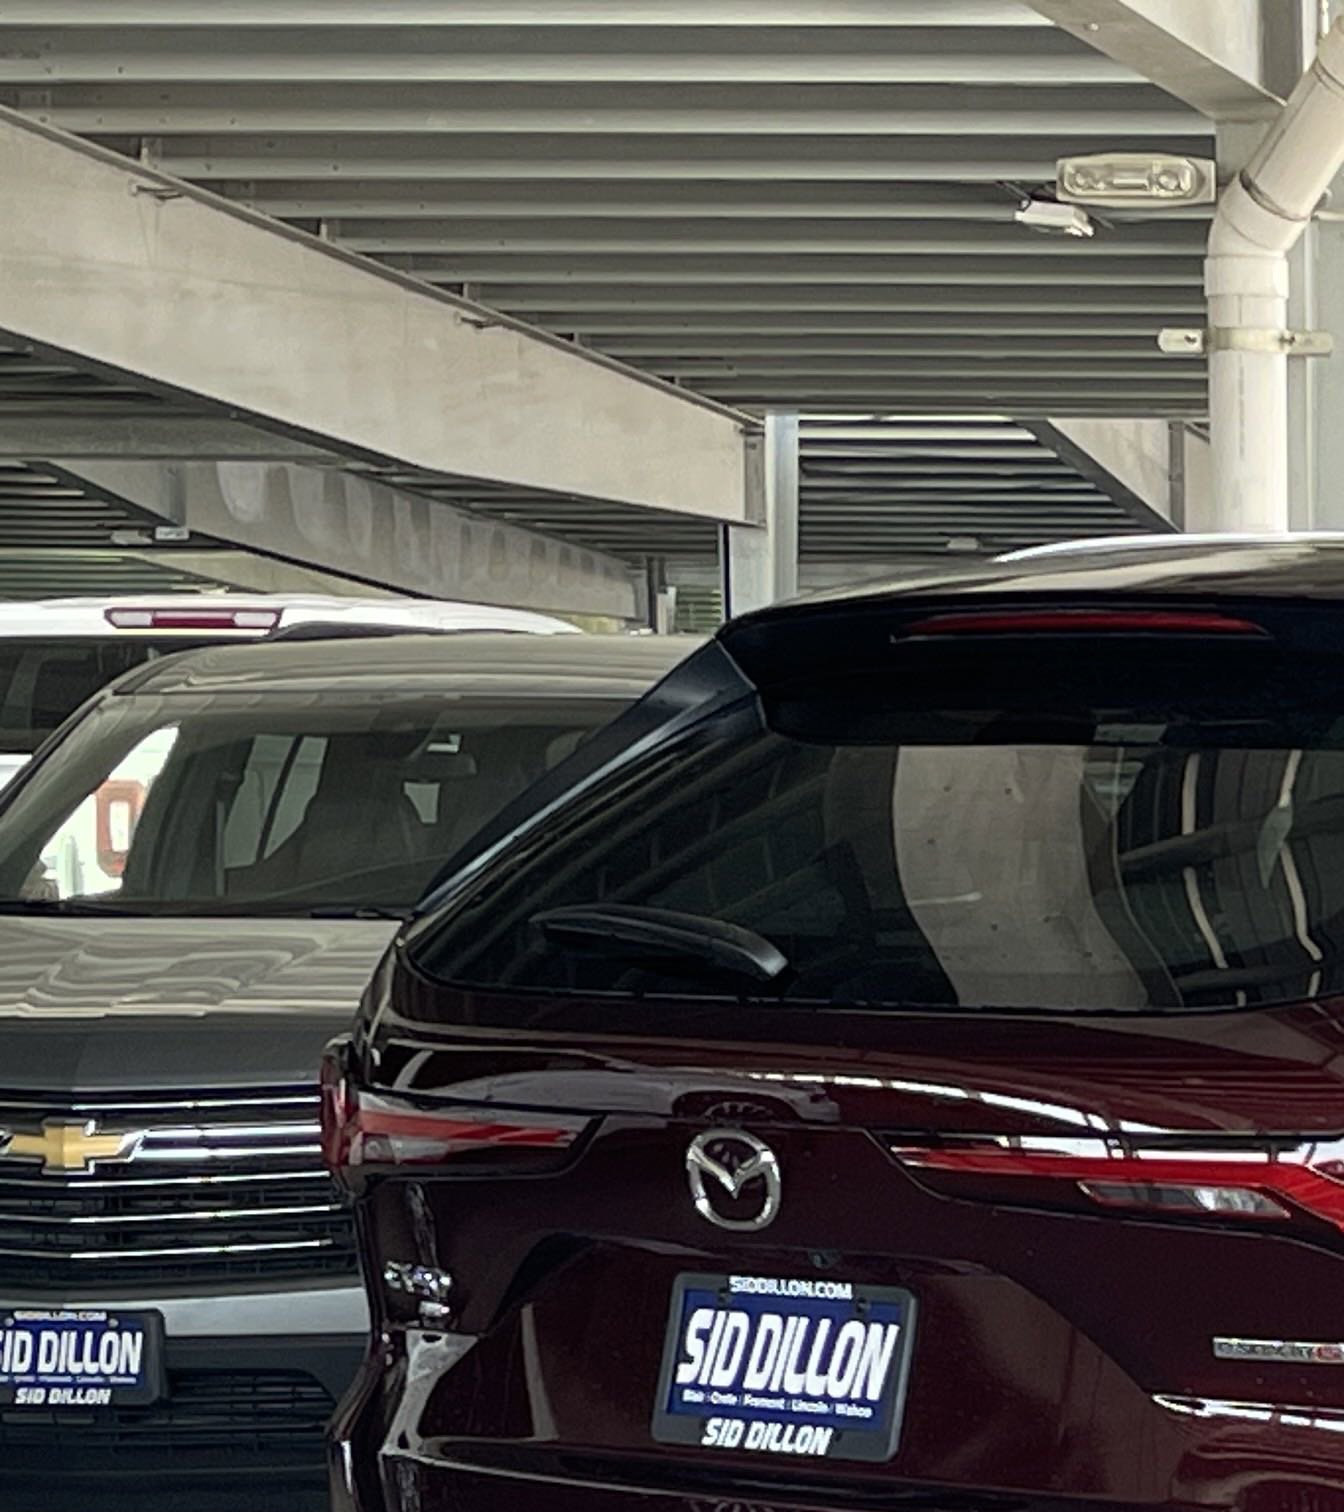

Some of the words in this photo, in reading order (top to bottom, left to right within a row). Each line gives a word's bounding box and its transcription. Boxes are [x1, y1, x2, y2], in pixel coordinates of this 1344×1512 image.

[729, 1275, 853, 1300] SIDDILLON.COM
[0, 1329, 33, 1374] ID
[37, 1330, 143, 1375] DILLON
[675, 1308, 750, 1387] SID
[742, 1313, 900, 1401] DILLON
[14, 1387, 46, 1405] SID
[47, 1388, 112, 1405] DILLON
[701, 1417, 746, 1448] SID
[744, 1420, 834, 1456] DILLON
